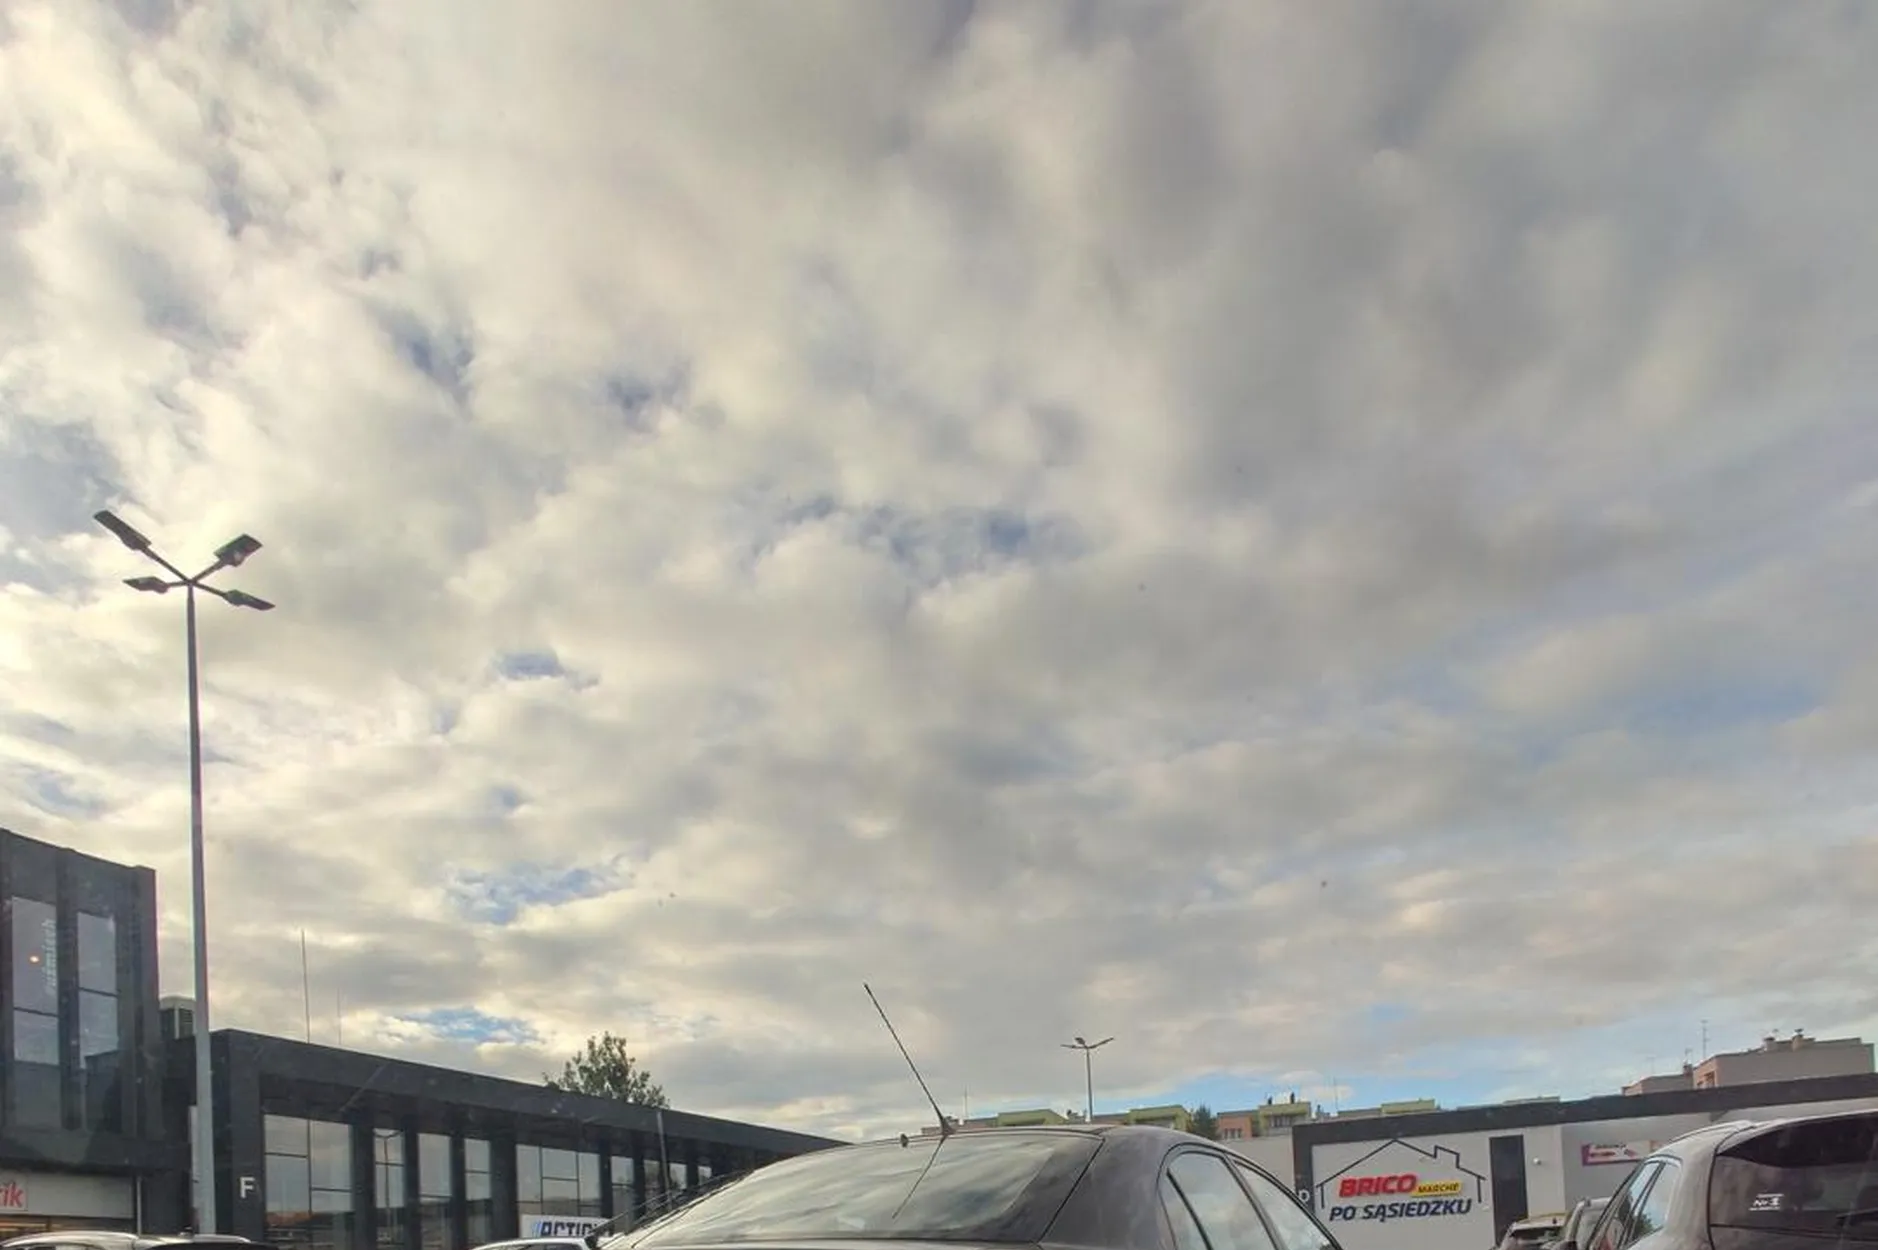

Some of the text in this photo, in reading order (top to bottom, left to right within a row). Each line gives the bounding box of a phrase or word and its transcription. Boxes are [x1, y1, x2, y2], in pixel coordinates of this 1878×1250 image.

[240, 1177, 255, 1199] F
[1339, 1174, 1417, 1198] BRICO
[1329, 1199, 1472, 1222] PO SĄSIEDZKU
